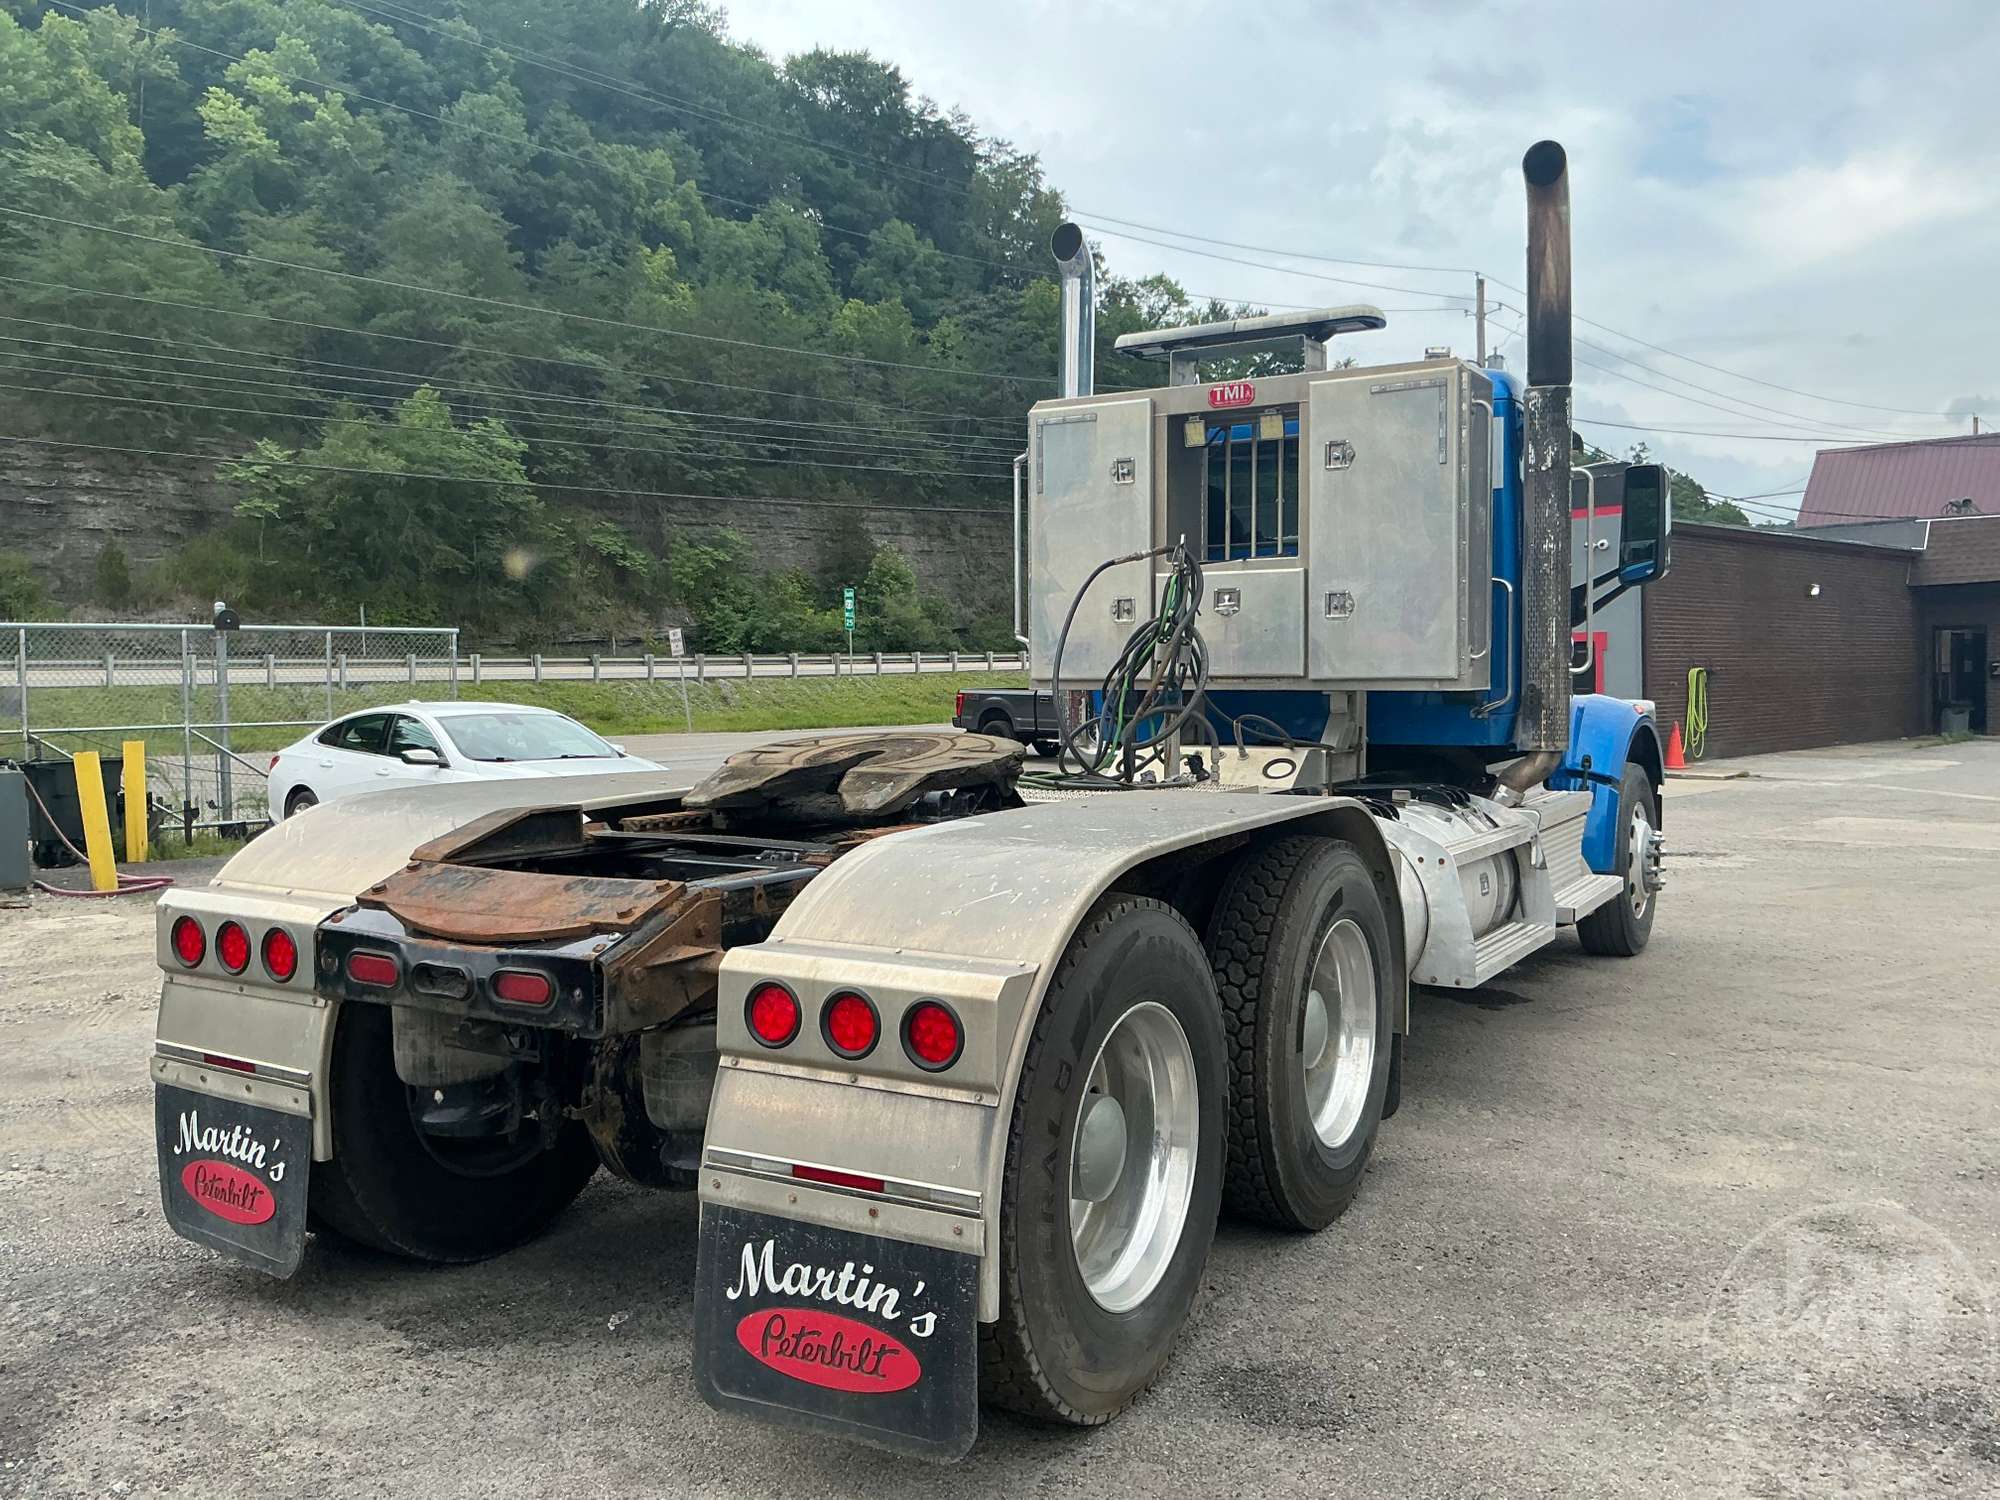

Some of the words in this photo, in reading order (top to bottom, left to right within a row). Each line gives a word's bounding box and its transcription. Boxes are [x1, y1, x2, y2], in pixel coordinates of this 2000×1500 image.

[1213, 385, 1245, 401] TMI
[174, 1110, 286, 1182] Martin's
[194, 1164, 265, 1212] Peterbilt
[726, 1239, 938, 1338] Martin's
[761, 1313, 899, 1379] Peterbilt
